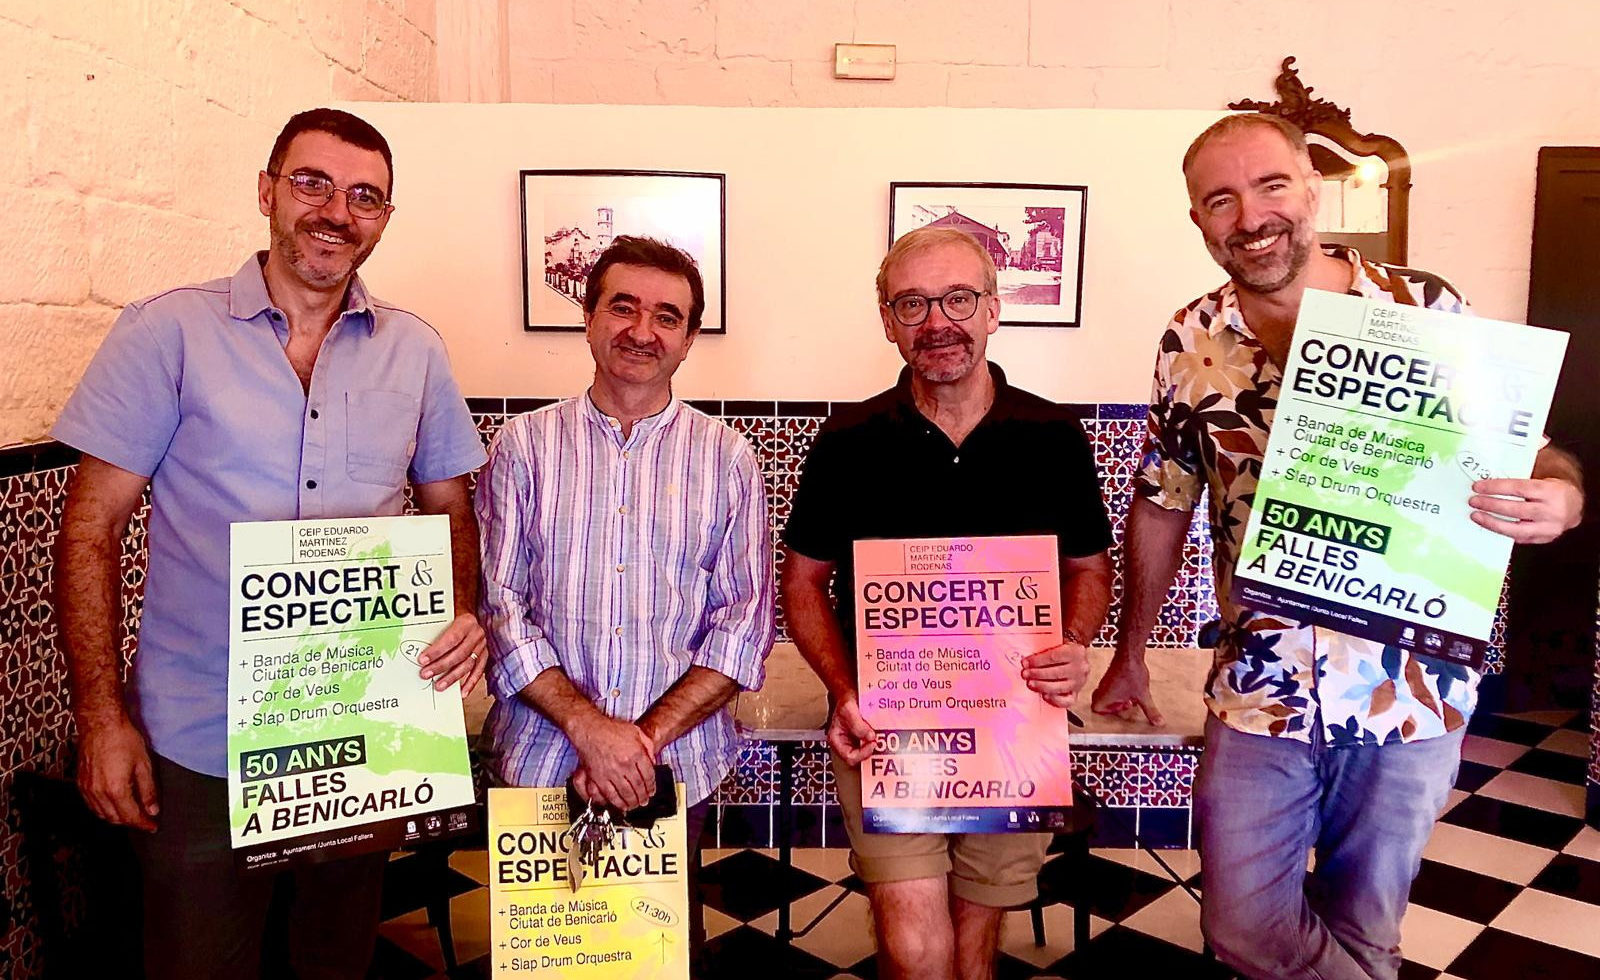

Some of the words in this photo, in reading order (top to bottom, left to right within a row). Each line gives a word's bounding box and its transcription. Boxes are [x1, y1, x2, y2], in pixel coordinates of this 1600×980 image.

[1300, 338, 1453, 391] CONCER
[1297, 415, 1344, 435] Banda
[1348, 427, 1367, 440] de
[1371, 431, 1426, 453] Música
[1294, 428, 1336, 448] Ciutat
[1340, 440, 1359, 453] de
[1363, 443, 1434, 470] Benicarló
[1289, 447, 1316, 463] Cor
[1319, 455, 1338, 468] de
[1343, 458, 1380, 478] Veus
[1284, 468, 1317, 488] Slap
[1321, 476, 1360, 496] Drum
[1365, 486, 1441, 514] Orquestra
[299, 527, 321, 536] CEIP
[324, 526, 369, 536] EDUARDO
[1265, 503, 1300, 529] 50
[1303, 512, 1386, 550] ANYS
[932, 544, 973, 553] EDUARDO
[1256, 528, 1360, 571] FALLES
[241, 565, 401, 600] CONCERT
[411, 559, 434, 587] &
[863, 579, 1004, 604] CONCERT
[1015, 576, 1038, 600] &
[1247, 554, 1267, 574] A
[1275, 560, 1448, 619] BENICARLÓ
[241, 591, 446, 633] ESPECTACLE
[864, 605, 1052, 630] ESPECTACLE
[253, 652, 300, 668] Banda
[304, 650, 321, 663] de
[326, 644, 374, 660] Música
[876, 648, 915, 660] Banda
[919, 648, 934, 659] de
[937, 647, 981, 659] Música
[876, 660, 912, 672] Ciutat
[915, 660, 930, 671] de
[934, 659, 991, 671] Benicarló
[252, 668, 295, 682] Ciutat
[299, 665, 317, 677] de
[321, 656, 384, 675] Benicarló
[252, 689, 279, 703] Cor
[283, 686, 300, 700] de
[306, 683, 340, 697] Veus
[877, 679, 898, 690] Cor
[902, 678, 918, 690] de
[922, 678, 952, 689] Veus
[252, 712, 285, 727] Slap
[290, 707, 328, 722] Drum
[332, 697, 399, 716] Orquestra
[878, 698, 905, 710] Slap
[909, 697, 941, 708] Drum
[945, 697, 1007, 711] Orquestra
[875, 733, 900, 752] 50
[906, 732, 972, 752] ANYS
[245, 752, 278, 778] 50
[286, 740, 362, 772] ANYS
[871, 758, 958, 777] FALES
[242, 771, 347, 808] FALLES
[542, 794, 560, 803] CEIP
[870, 781, 886, 799] A
[241, 812, 262, 837] A
[272, 778, 434, 831] BENICARLÓ
[498, 853, 677, 884] ESPETACLE
[509, 904, 547, 917] Banda
[550, 902, 564, 913] de
[568, 899, 608, 912] Música
[509, 917, 544, 930] Ciutat
[547, 915, 561, 927] de
[565, 911, 617, 925] Benicarló
[635, 900, 672, 923] 21:30h
[510, 936, 531, 949] Cor
[535, 935, 550, 948] de
[553, 933, 582, 945] Veus
[511, 958, 537, 972] Slap
[541, 954, 573, 968] Drum
[576, 950, 632, 967] Orquestra
